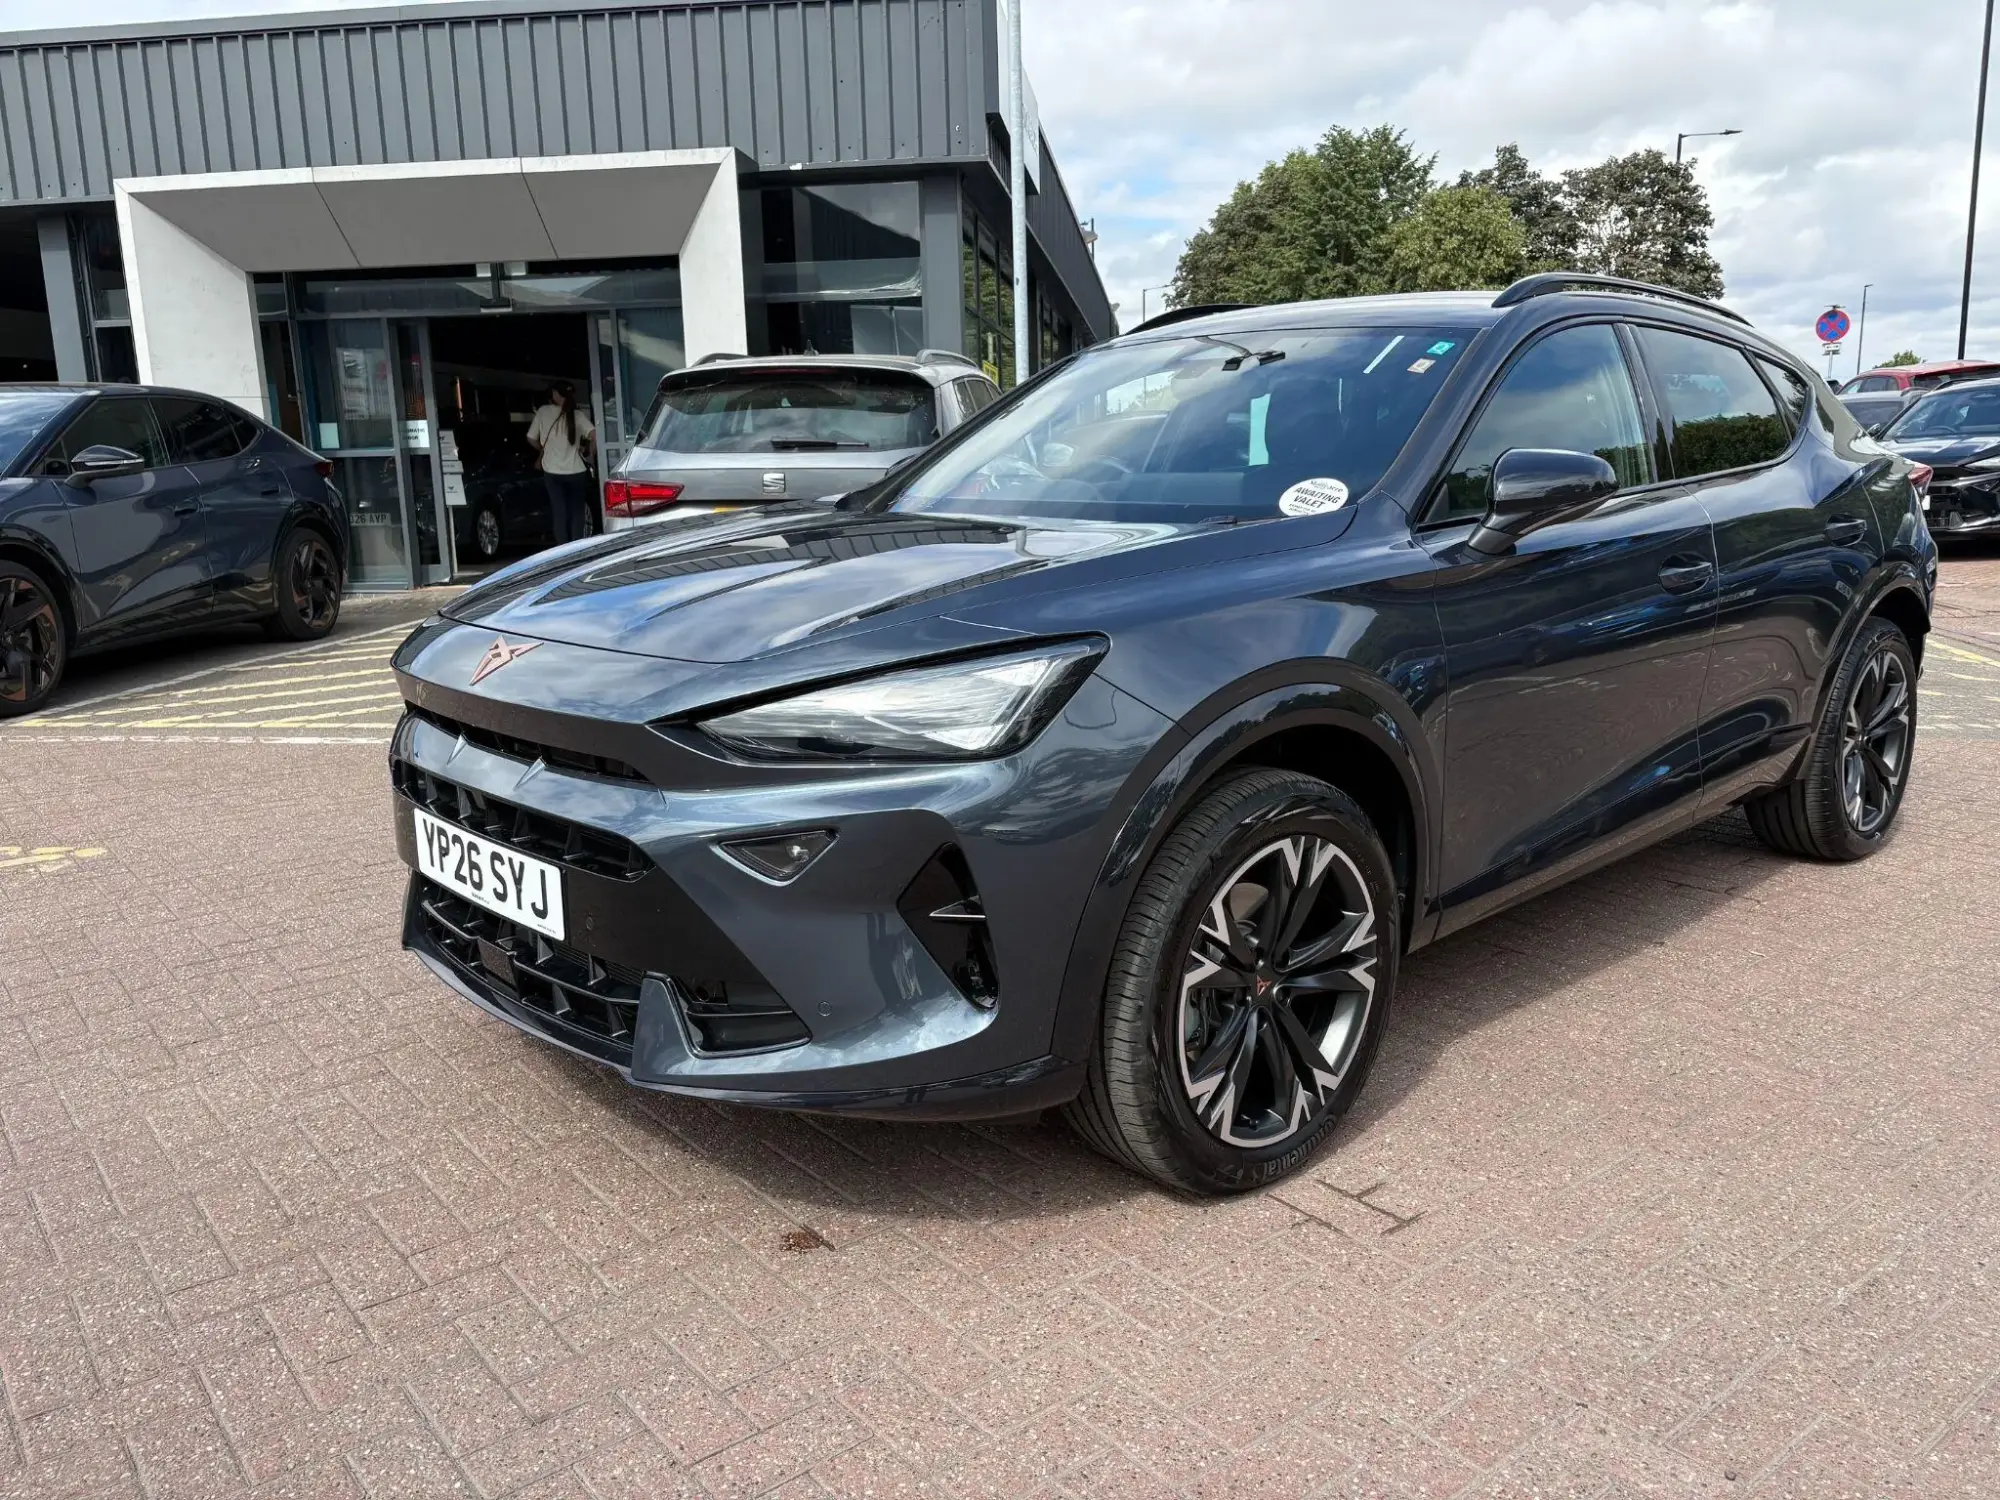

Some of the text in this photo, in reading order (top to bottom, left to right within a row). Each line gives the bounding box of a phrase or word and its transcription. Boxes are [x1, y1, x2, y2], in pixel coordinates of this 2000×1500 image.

[1293, 495, 1326, 509] VALET
[1294, 486, 1341, 504] AWAITING
[423, 818, 549, 920] YP26 SYJ
